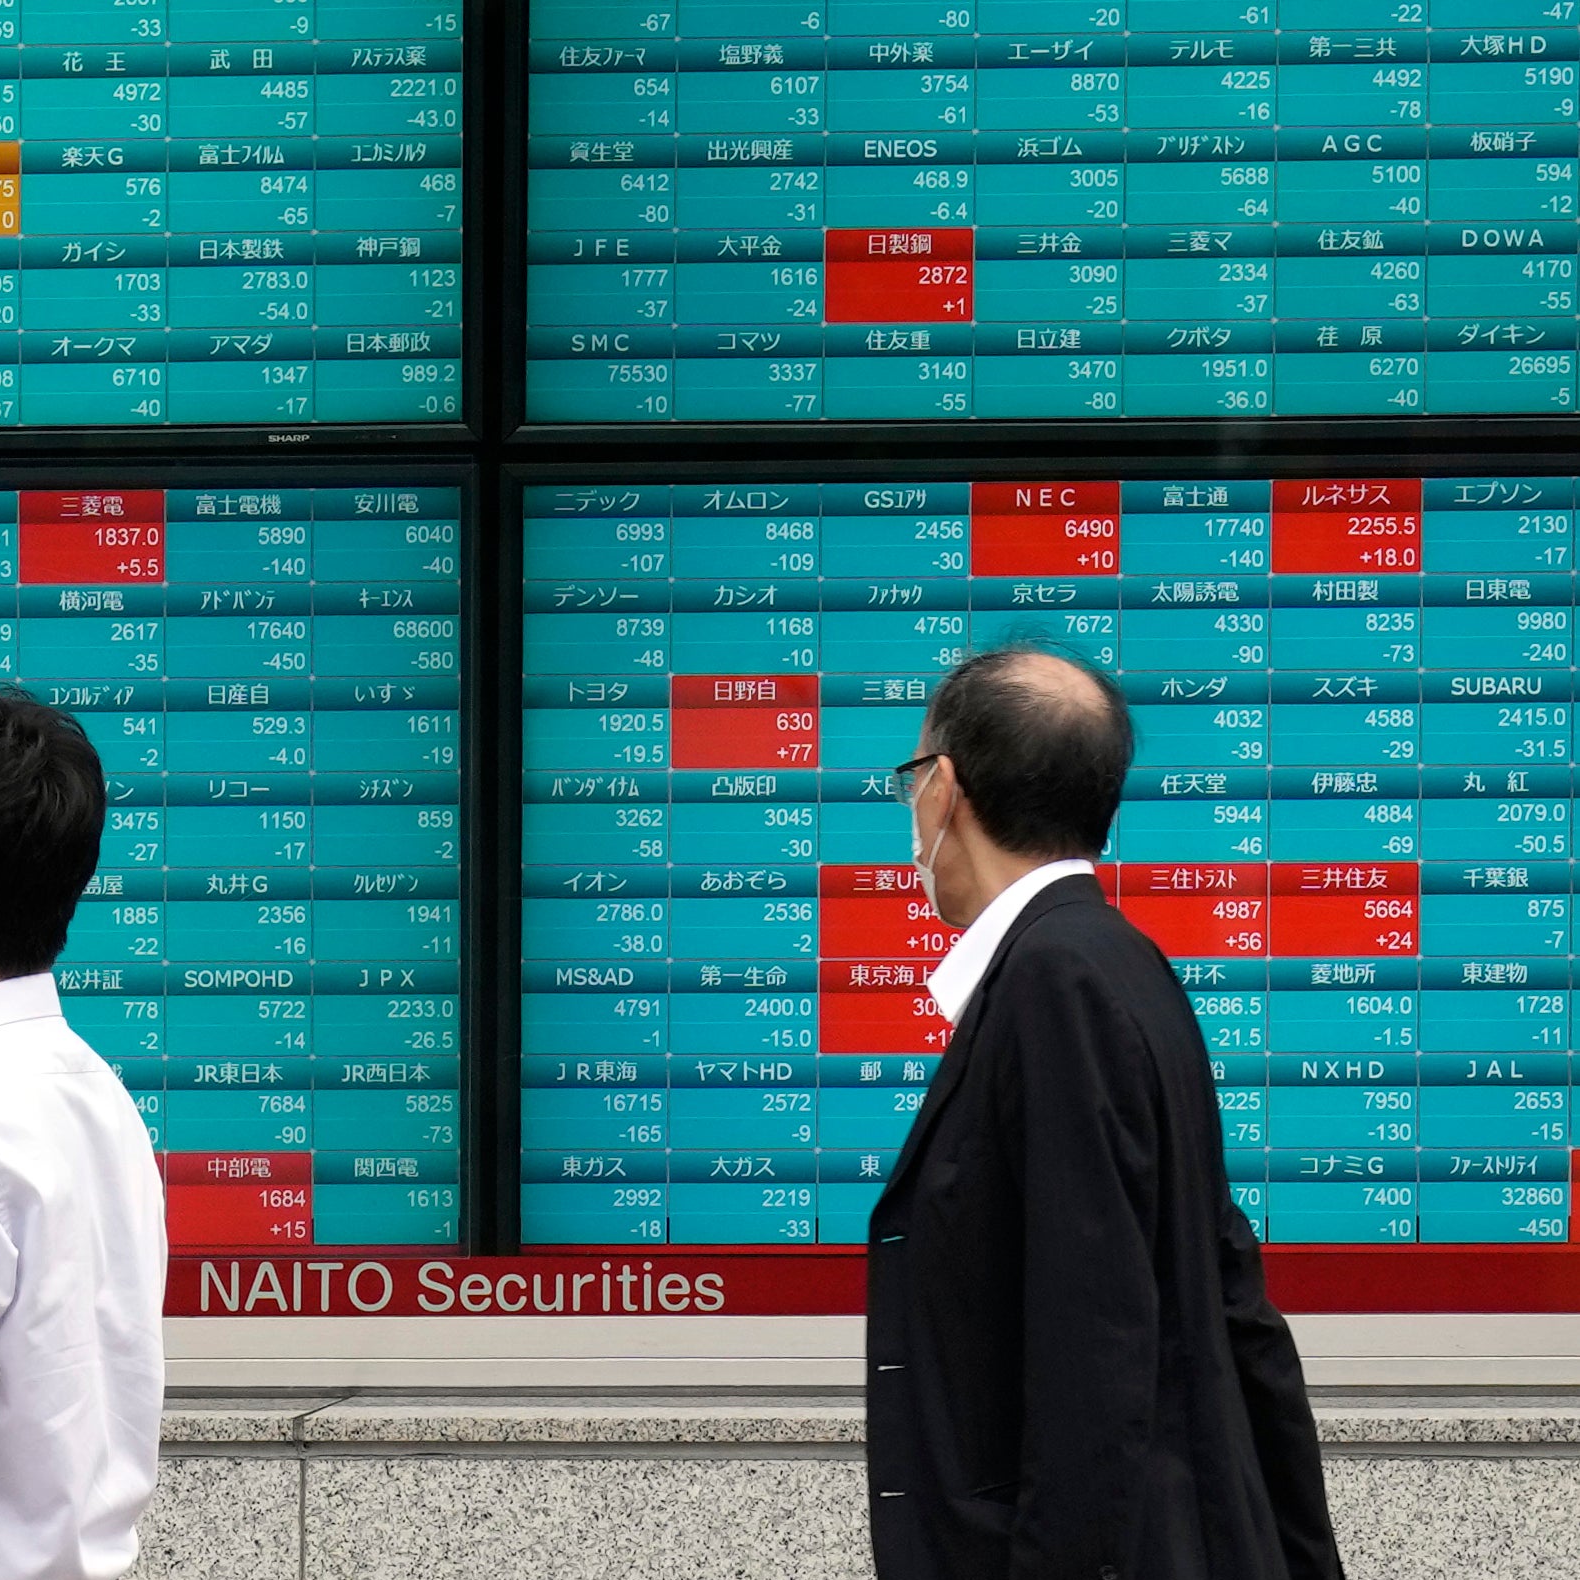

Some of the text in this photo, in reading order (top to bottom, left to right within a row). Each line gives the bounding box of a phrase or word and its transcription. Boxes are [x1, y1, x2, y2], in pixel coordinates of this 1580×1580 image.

[719, 43, 784, 65] 塩野義
[869, 41, 934, 63] 中外薬
[1008, 39, 1094, 61] エーザイ
[1171, 39, 1234, 60] テルモ
[1309, 35, 1397, 58] 第一三共
[112, 82, 161, 102] 4972
[260, 80, 309, 99] 4485
[390, 78, 457, 98] 2221.0
[633, 78, 670, 97] 654
[569, 141, 634, 163] 資生堂
[707, 138, 794, 161] 出光興産
[864, 139, 938, 159] ENEOS
[1017, 135, 1083, 158] 浜ゴム
[1469, 131, 1537, 152] 板硝子
[61, 146, 124, 168] 楽天G
[260, 175, 308, 195] 8474
[419, 173, 456, 192] 468
[1220, 166, 1269, 186] 5688
[199, 238, 284, 260] 日本製鉄
[355, 236, 421, 258] 神戸鋼
[717, 234, 782, 256] 大平金
[868, 233, 932, 255] 日製鋼
[1016, 231, 1082, 254] 三井金
[1167, 230, 1233, 252] 三菱マ
[1317, 229, 1384, 251] 住友鉱
[62, 241, 126, 263] ガイシ
[210, 333, 273, 355] アマダ
[346, 331, 431, 354] 日本郵政
[717, 332, 781, 352] コマツ
[865, 329, 931, 351] 住友重
[1017, 327, 1082, 350] 日立建
[1167, 326, 1232, 348] クボタ
[1457, 323, 1546, 345] ダイキン
[51, 336, 137, 357] オークマ
[1369, 357, 1419, 376] 6270
[267, 433, 311, 443] SHARP
[354, 493, 420, 514] 安川電
[554, 489, 640, 512] ニデック
[703, 489, 789, 511] オムロン
[1162, 484, 1229, 507] 富士通
[1301, 483, 1391, 506] ルネサス
[1453, 480, 1542, 505] エプソン
[60, 495, 125, 517] 三菱電
[195, 493, 282, 516] 富士電機
[914, 520, 964, 540] 2456
[553, 584, 639, 607] デンソー
[713, 584, 778, 606] カシオ
[1011, 583, 1077, 604] 京セラ
[1151, 581, 1240, 603] 太陽誘電
[1312, 579, 1379, 602] 村田製
[1466, 578, 1532, 601] 日東電
[58, 590, 125, 612] 横河電
[247, 621, 306, 640] 17640
[393, 620, 454, 639] 68600
[913, 616, 963, 635] 4750
[208, 683, 269, 705] 日産自
[569, 681, 629, 702] トヨタ
[714, 678, 776, 701] 日野自
[1161, 676, 1228, 698] ホンダ
[1312, 675, 1379, 698] スズキ
[1451, 676, 1542, 696] SUBARU
[209, 779, 270, 799] リコー
[711, 774, 777, 797] 凸版印
[1160, 772, 1227, 795] 任天堂
[1311, 771, 1378, 794] 伊藤忠
[111, 811, 159, 831] 3475
[417, 810, 454, 829] 859
[615, 808, 663, 827] 3262
[1497, 803, 1566, 822] 2079.0
[206, 873, 268, 895] 丸井G
[563, 871, 627, 892] イオン
[700, 869, 787, 892] あおぞら
[1300, 867, 1388, 889] 三井住友
[1463, 866, 1529, 888] 千葉銀
[112, 906, 159, 925] 1885
[407, 905, 451, 923] 1941
[1212, 900, 1262, 920] 4987
[184, 969, 294, 988] SOMPOHD
[556, 967, 634, 986] MS&AD
[700, 964, 788, 987] 第一生命
[1310, 962, 1376, 985] 菱地所
[1461, 961, 1528, 985] 東建物
[124, 1001, 158, 1019] 778
[193, 1061, 283, 1085] JR東日本
[341, 1062, 431, 1083] JR西日本
[695, 1060, 793, 1082] ヤマトHD
[207, 1157, 272, 1179] 中部電
[354, 1157, 419, 1178] 関西電
[561, 1155, 627, 1178] 東ガス
[710, 1156, 776, 1177] 大ガス
[1300, 1154, 1384, 1176] コナミG
[200, 1260, 726, 1313] NAITO Securities
